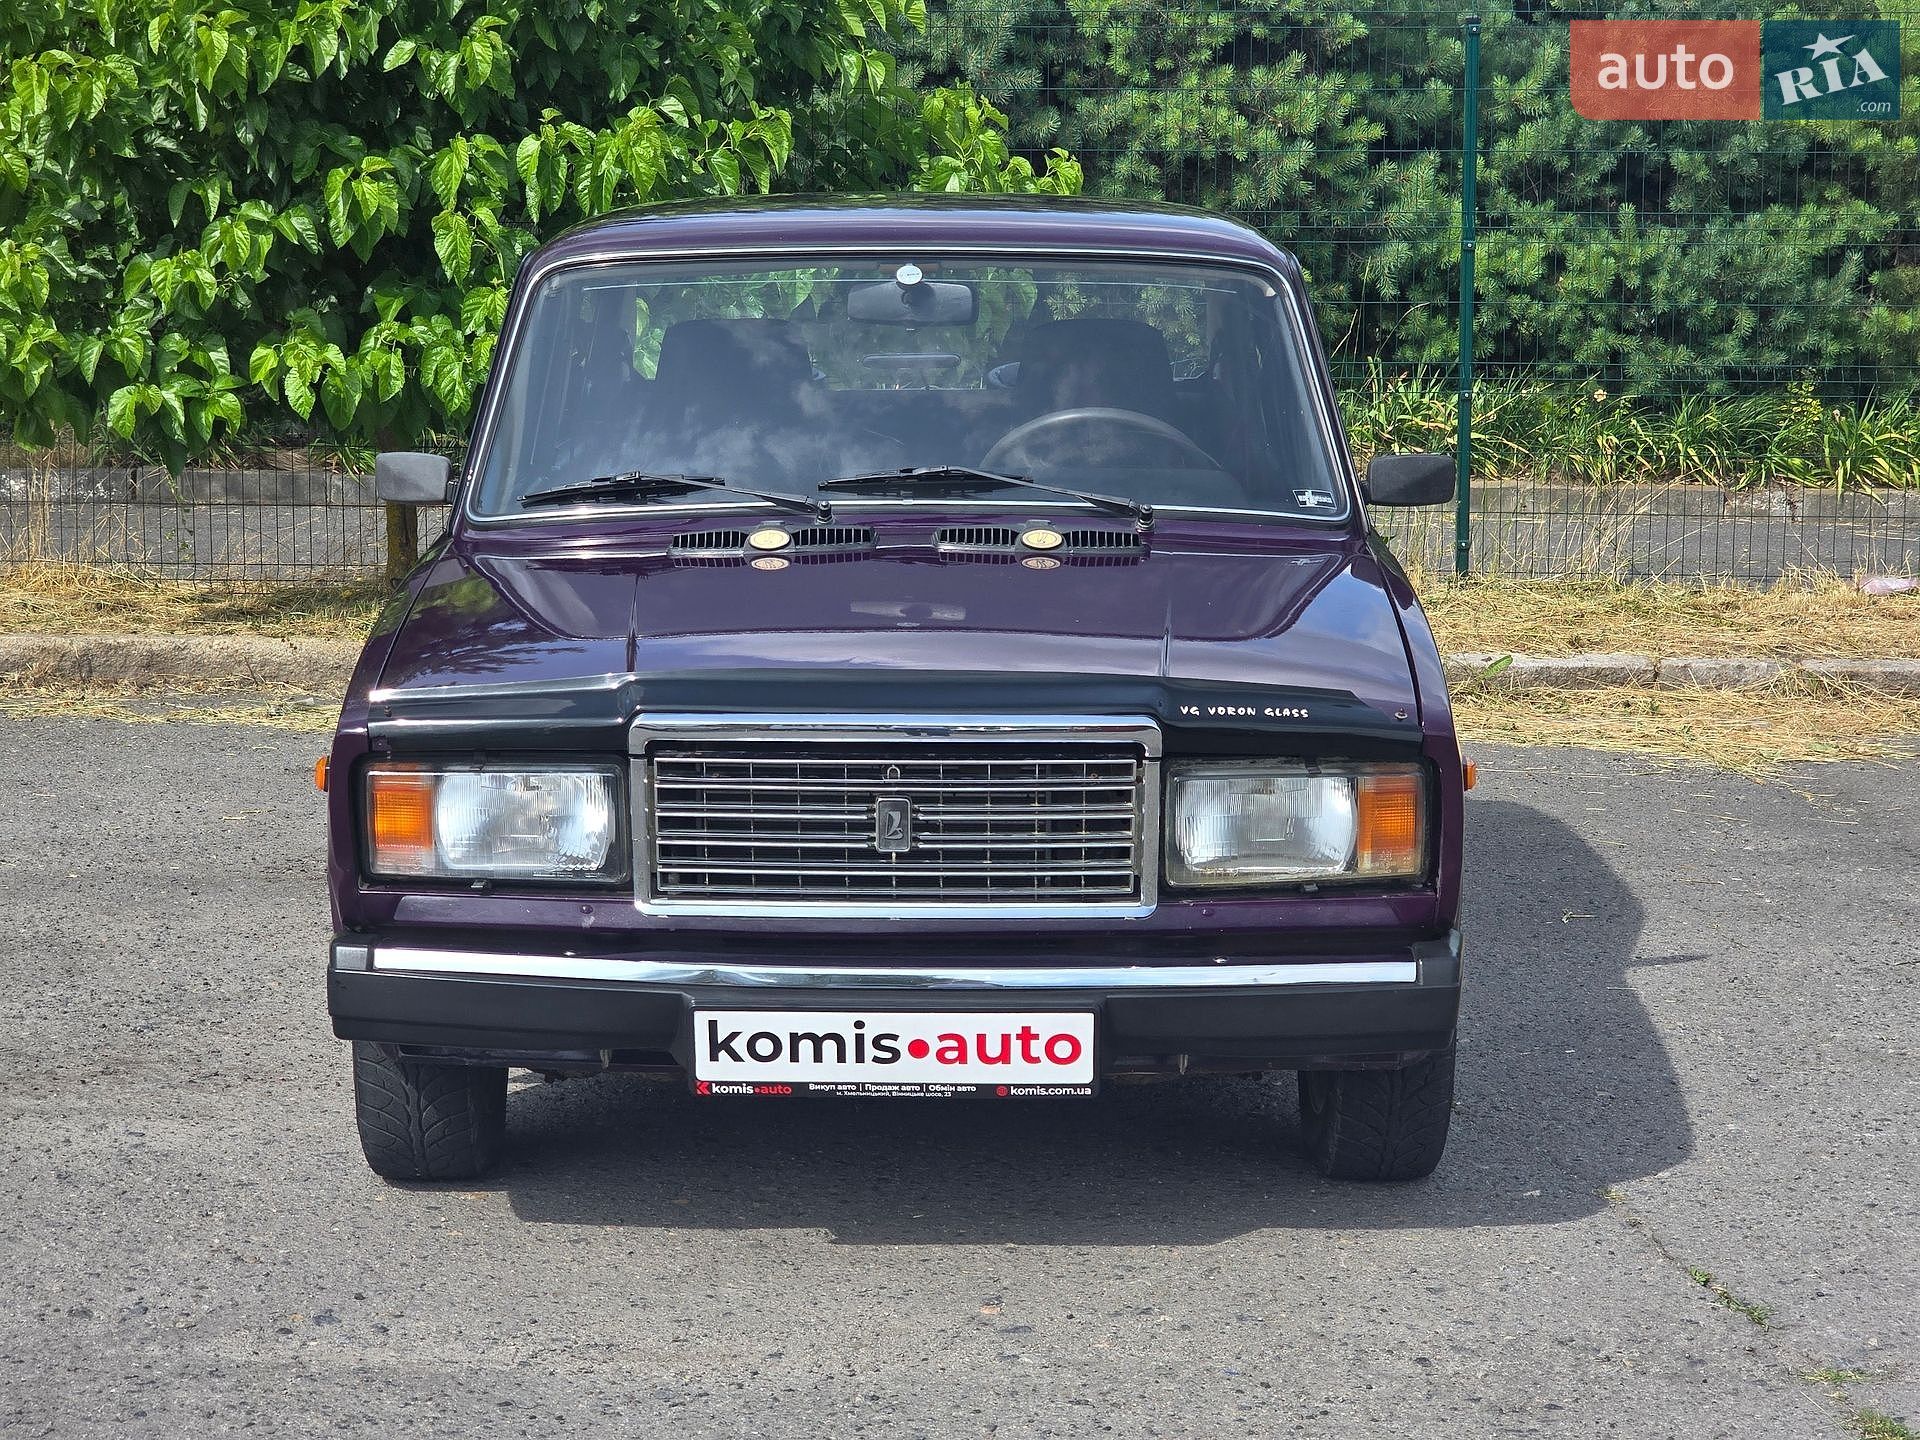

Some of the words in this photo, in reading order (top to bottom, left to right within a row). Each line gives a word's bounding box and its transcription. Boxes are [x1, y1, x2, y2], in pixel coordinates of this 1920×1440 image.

[1180, 705, 1200, 717] VG
[1207, 706, 1256, 717] VORON
[1264, 707, 1309, 718] GLASS
[808, 1083, 836, 1092] Викуп
[864, 1083, 900, 1092] Продаж
[928, 1084, 956, 1092] Обмін
[1010, 1085, 1092, 1096] komis.com.ua
